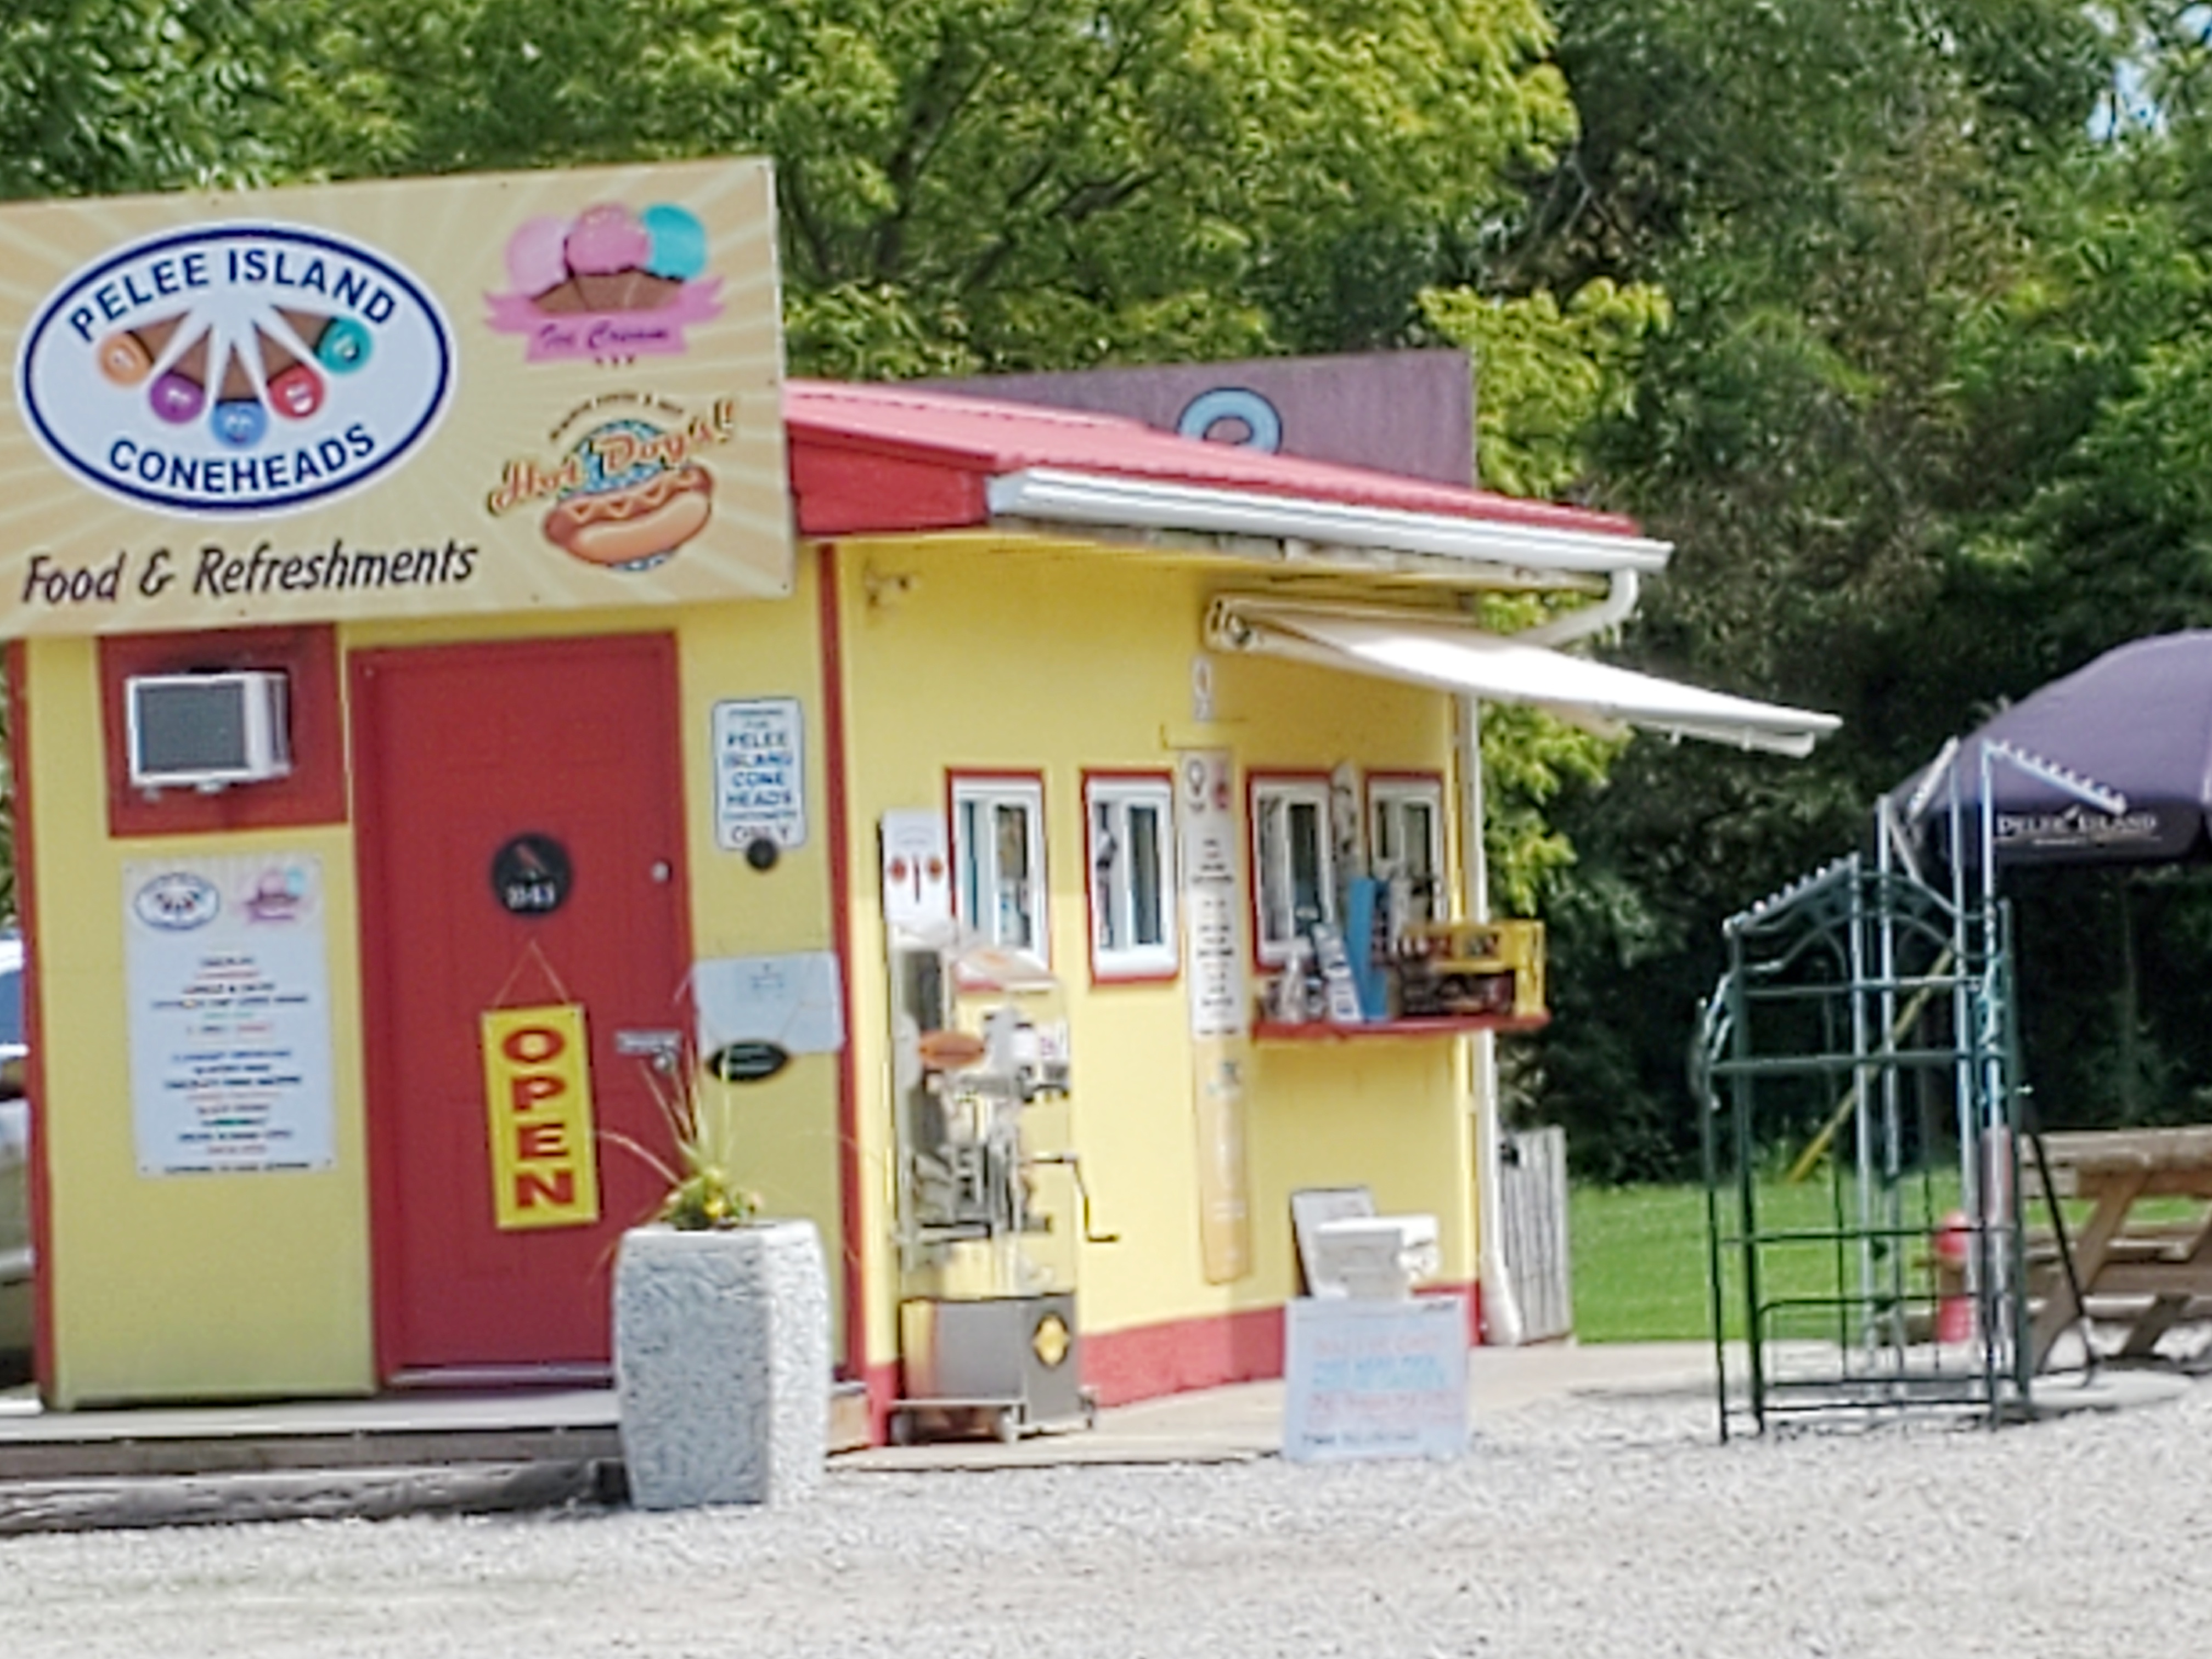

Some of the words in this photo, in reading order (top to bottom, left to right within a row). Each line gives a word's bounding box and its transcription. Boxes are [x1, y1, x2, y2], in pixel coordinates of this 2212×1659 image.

[70, 252, 210, 342] PELEE
[228, 249, 397, 327] ISLAND
[110, 422, 376, 493] CONEHEADS
[487, 458, 578, 517] Hot
[22, 550, 127, 605] Food
[139, 547, 174, 597] &
[193, 539, 479, 598] Refreshments
[502, 1025, 575, 1207] OPEN
